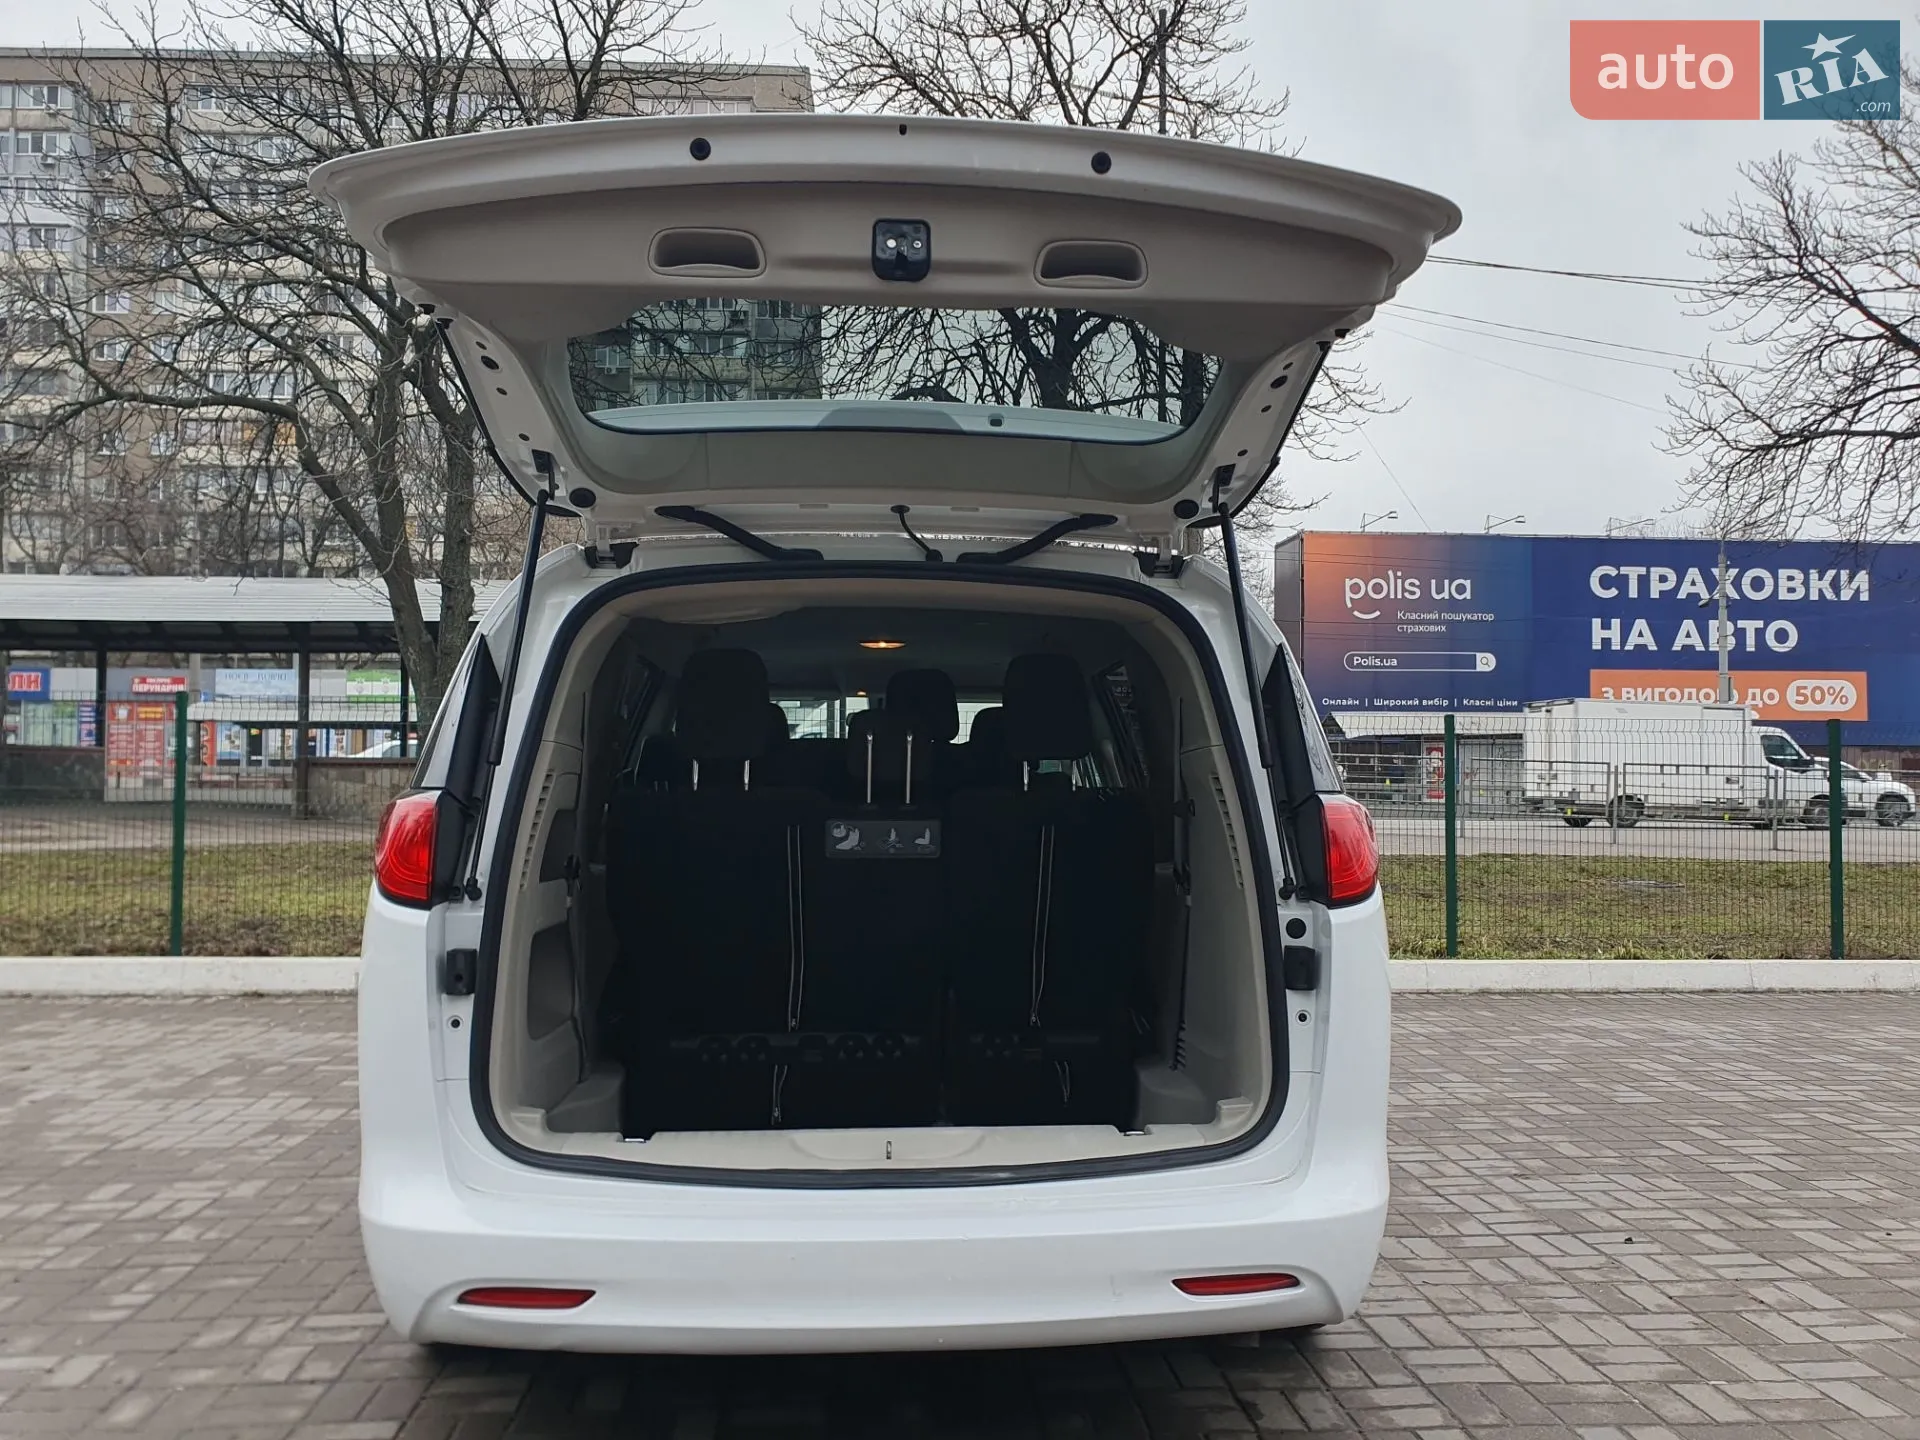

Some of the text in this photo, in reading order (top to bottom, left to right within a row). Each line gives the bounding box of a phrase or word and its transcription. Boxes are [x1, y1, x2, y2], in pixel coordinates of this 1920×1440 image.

[1345, 569, 1472, 609] polis ua
[1589, 565, 1870, 602] СТРАХОВКИ
[1397, 610, 1495, 623] Класний пошукатор
[1397, 623, 1447, 634] страхових
[1591, 617, 1799, 653] НА АВТО
[1353, 655, 1398, 668] Polis.ua
[1322, 697, 1518, 708] Онлайн Широкий вибір Класні ціни
[1795, 685, 1849, 705] 50%
